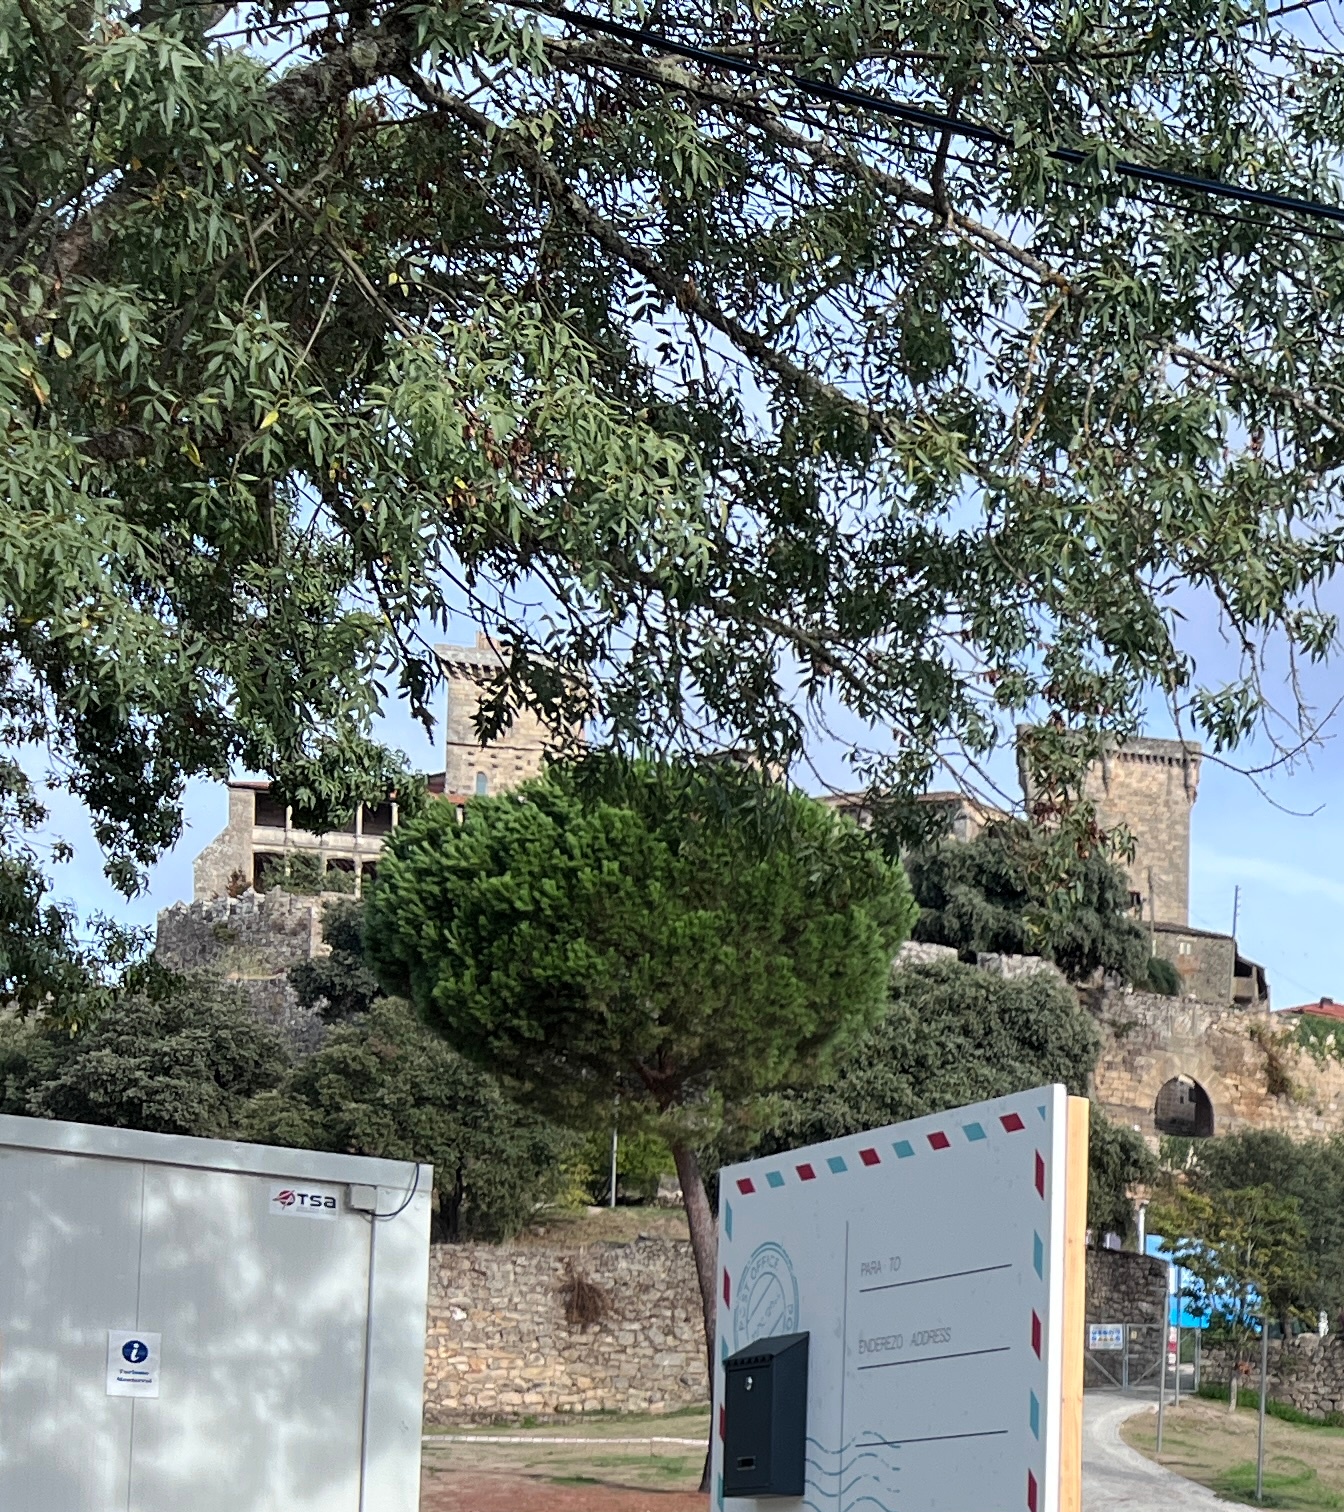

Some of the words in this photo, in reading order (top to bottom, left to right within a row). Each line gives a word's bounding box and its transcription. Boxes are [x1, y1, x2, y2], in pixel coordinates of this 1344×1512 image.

[860, 1260, 882, 1277] PARA
[888, 1255, 902, 1272] TO
[909, 1326, 952, 1347] ADDRESS
